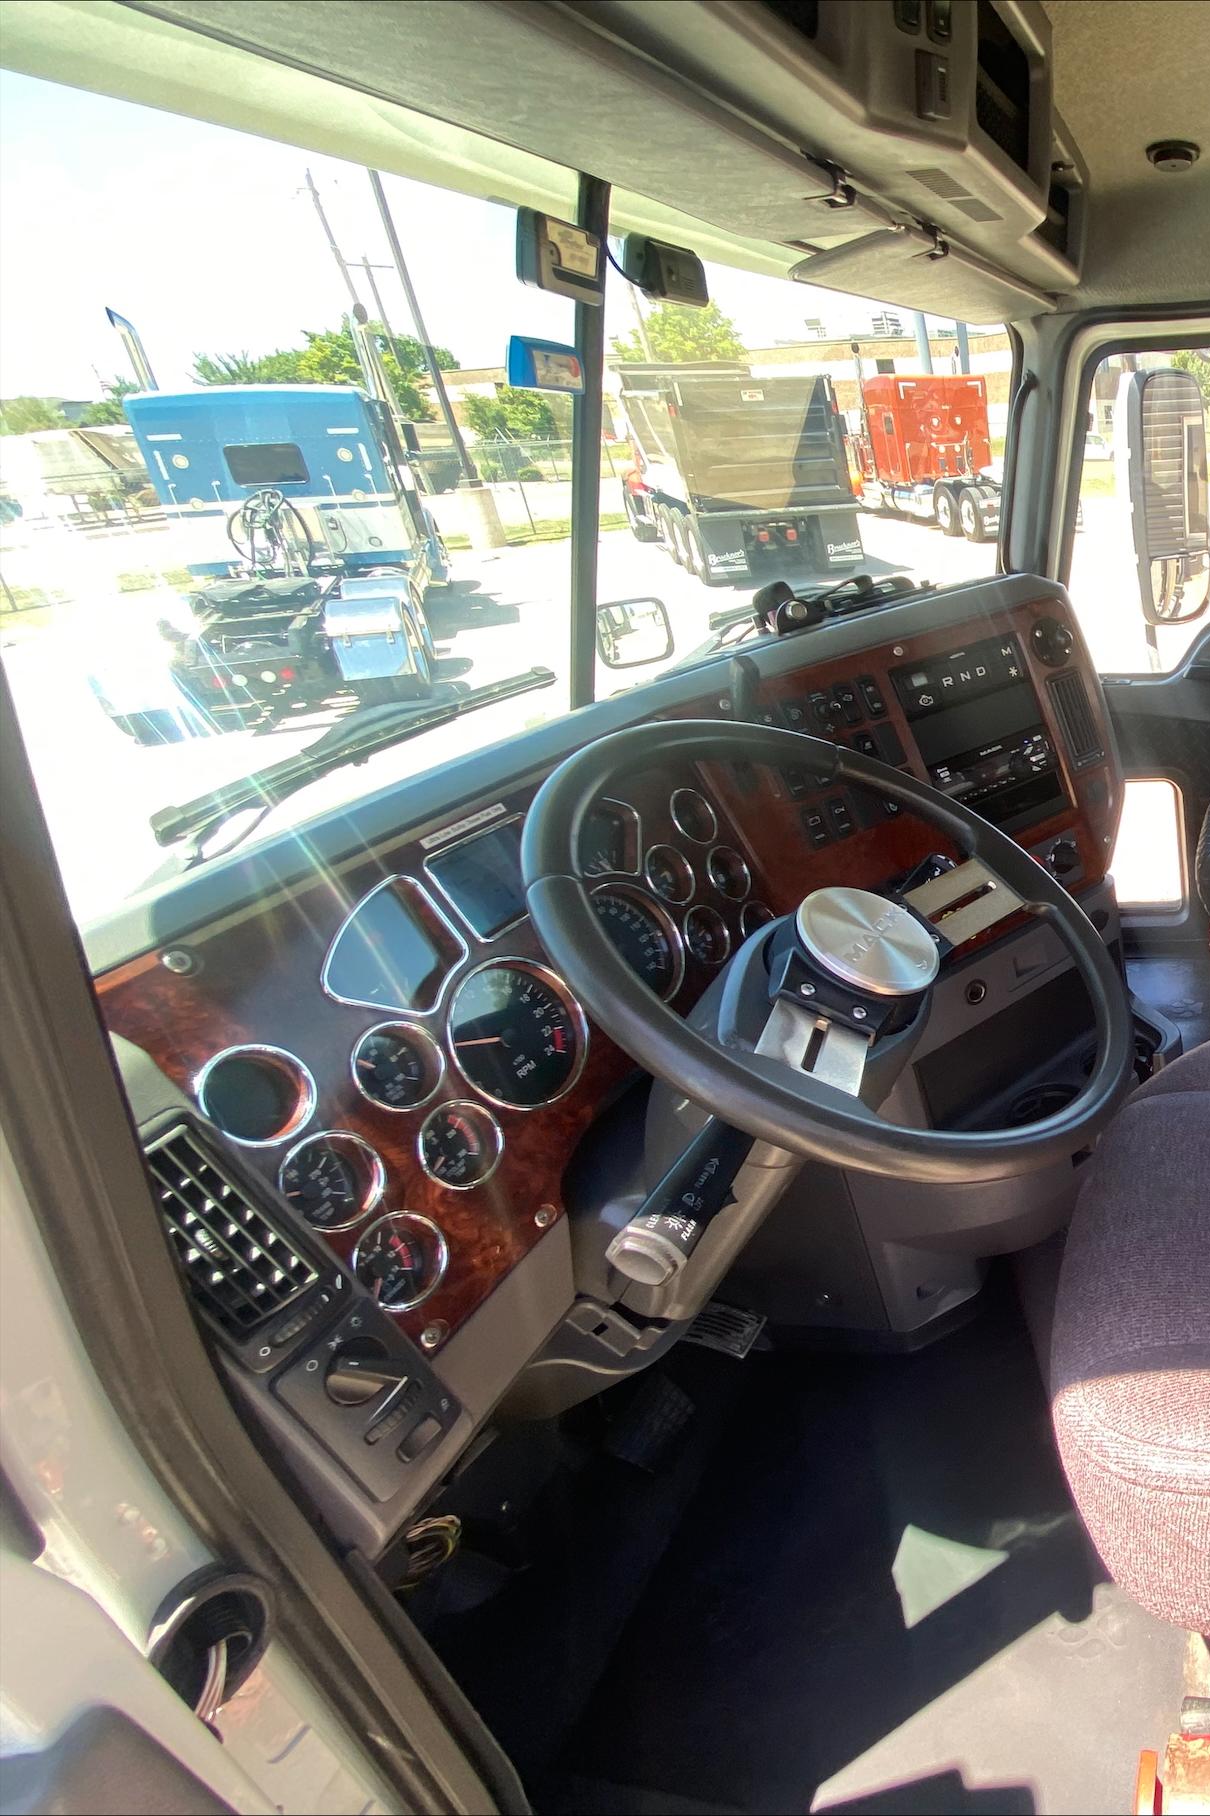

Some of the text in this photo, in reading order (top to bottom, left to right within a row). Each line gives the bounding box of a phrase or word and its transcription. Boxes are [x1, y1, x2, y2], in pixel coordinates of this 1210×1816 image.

[1001, 646, 1012, 657] M
[942, 666, 986, 688] R N D
[844, 906, 906, 962] MACK
[520, 993, 531, 1004] 18
[533, 1007, 545, 1018] 20
[541, 1025, 552, 1037] 22
[544, 1044, 556, 1056] 24
[516, 1060, 537, 1079] RPM
[680, 1219, 697, 1241] FLASH
